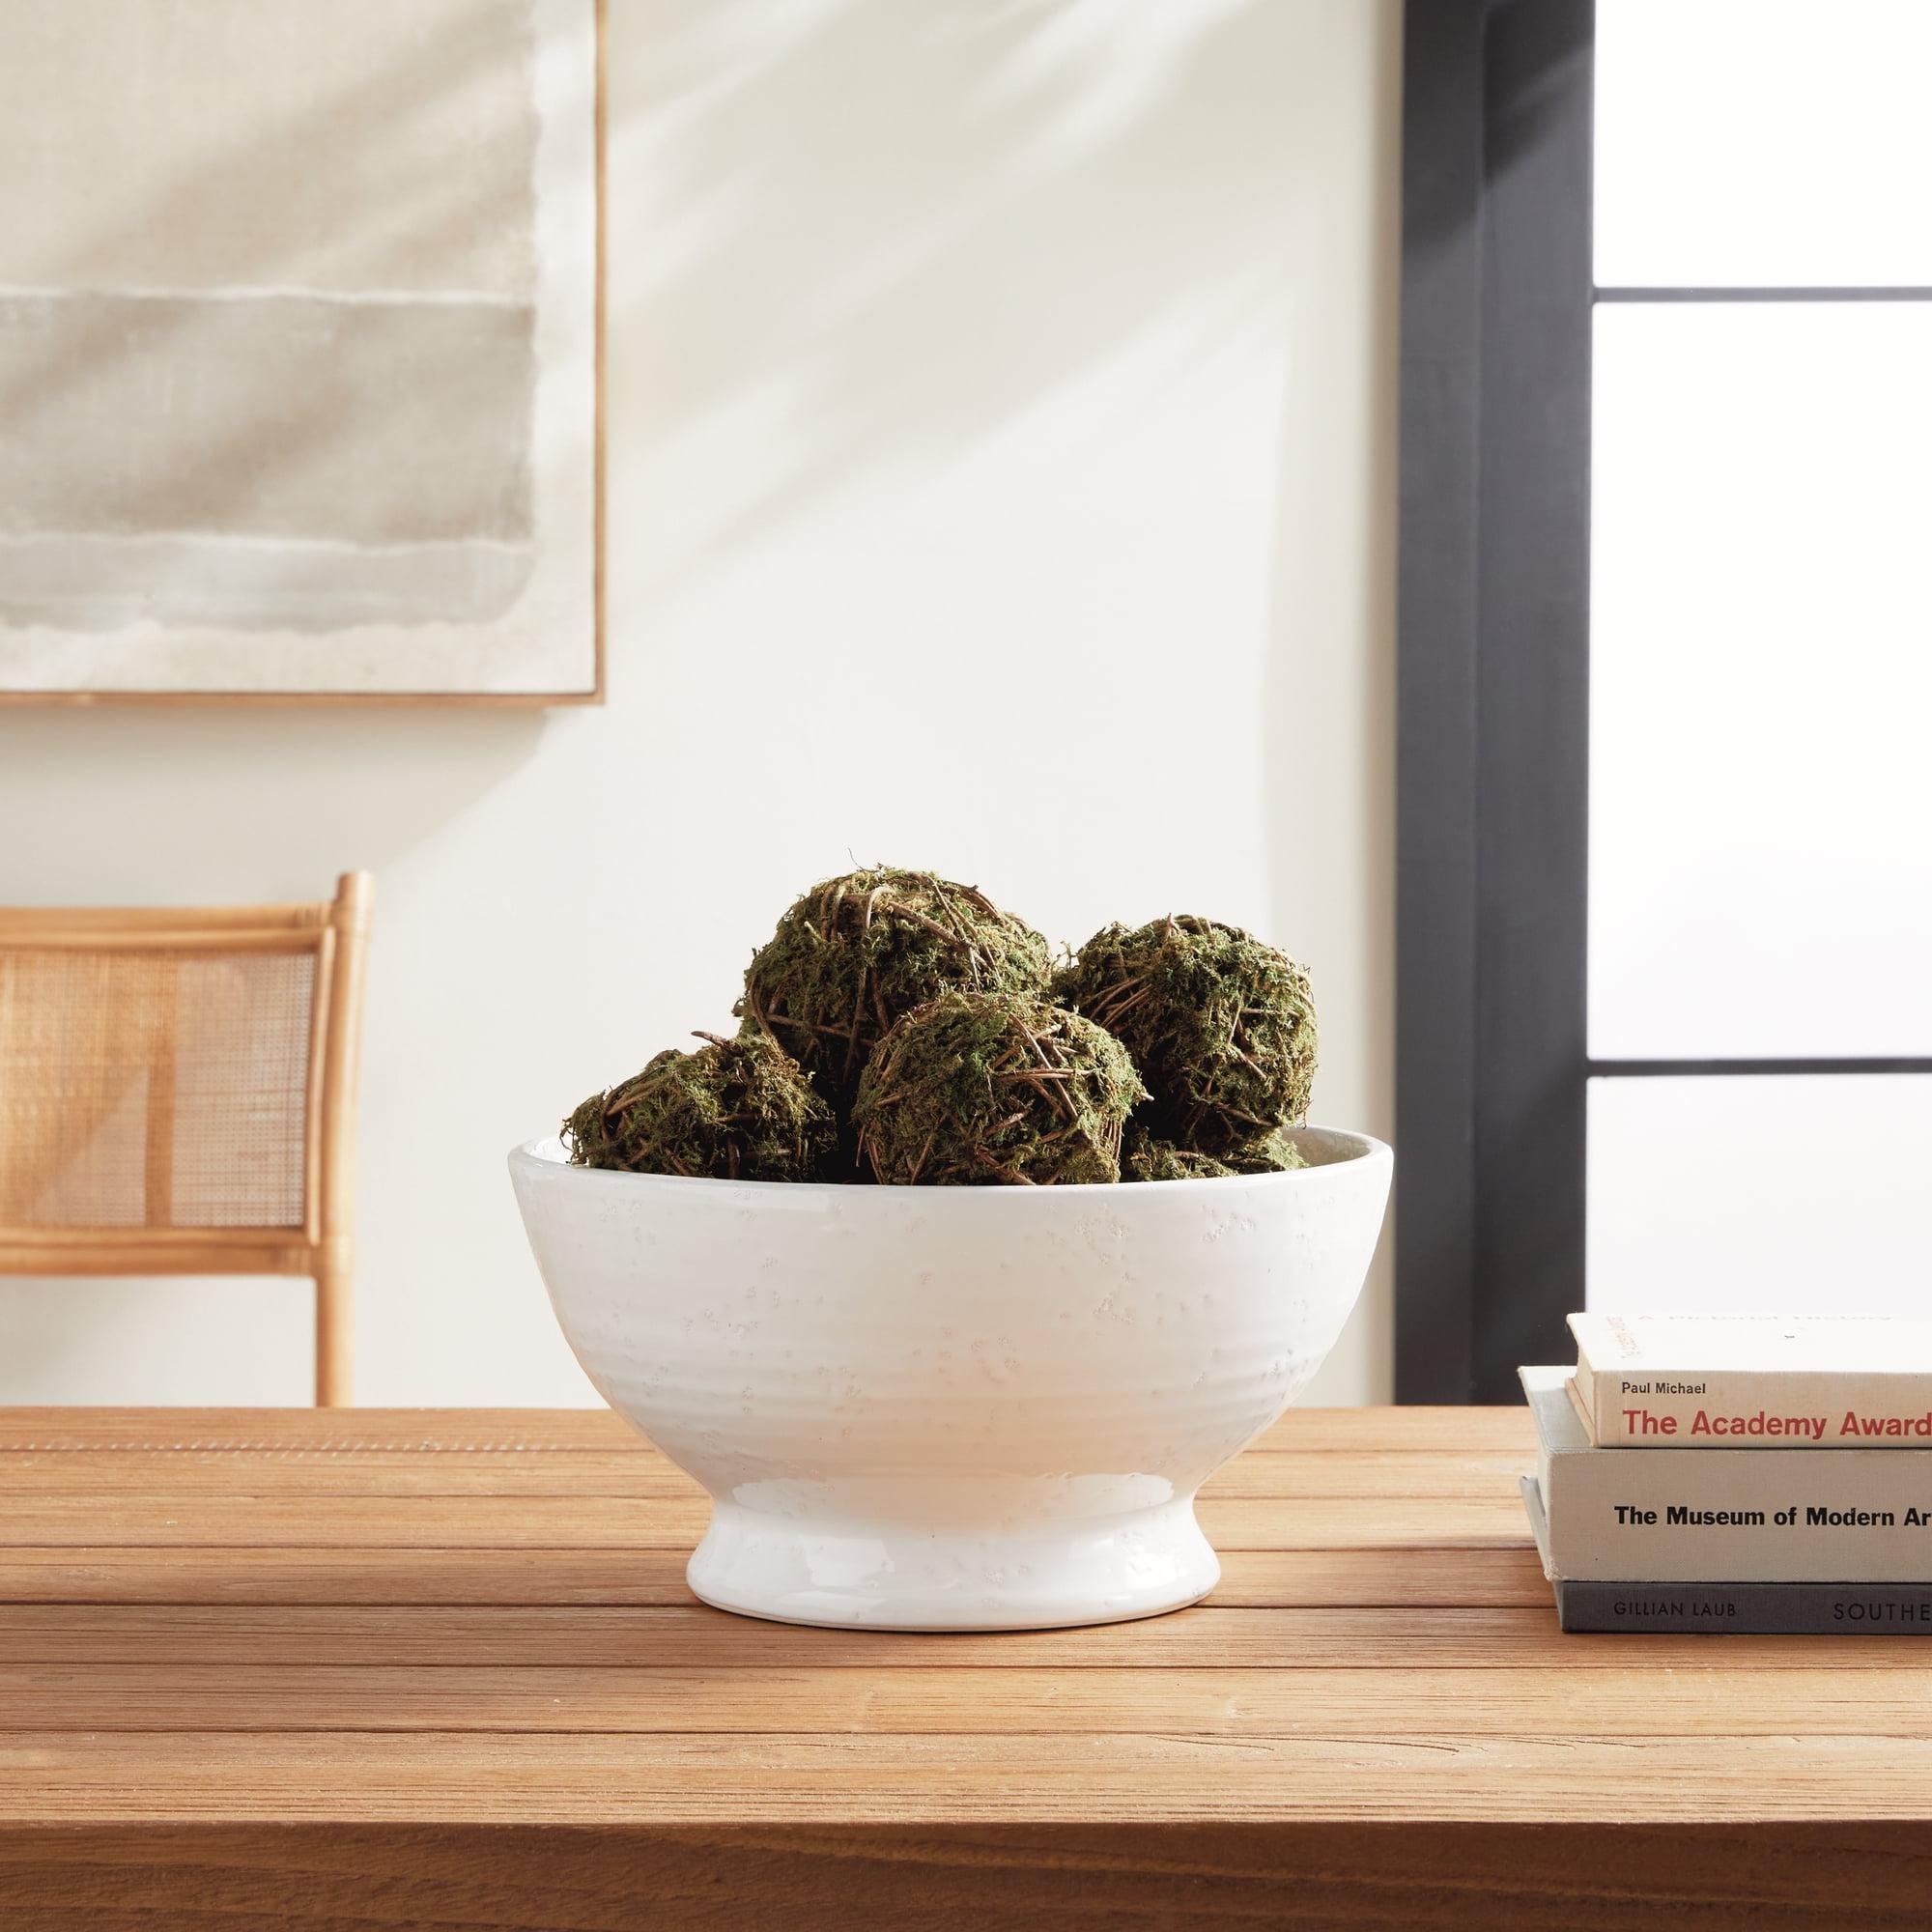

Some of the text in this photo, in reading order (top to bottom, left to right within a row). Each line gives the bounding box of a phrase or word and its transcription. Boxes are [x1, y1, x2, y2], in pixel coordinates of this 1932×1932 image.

[1621, 1381, 1706, 1395] Paul Michael
[1622, 1409, 1932, 1440] The Academy Award
[1614, 1505, 1932, 1526] The Museum of Modern Ar
[1613, 1602, 1736, 1617] GILLIAN LAUB
[1833, 1603, 1931, 1622] SOUTHE
